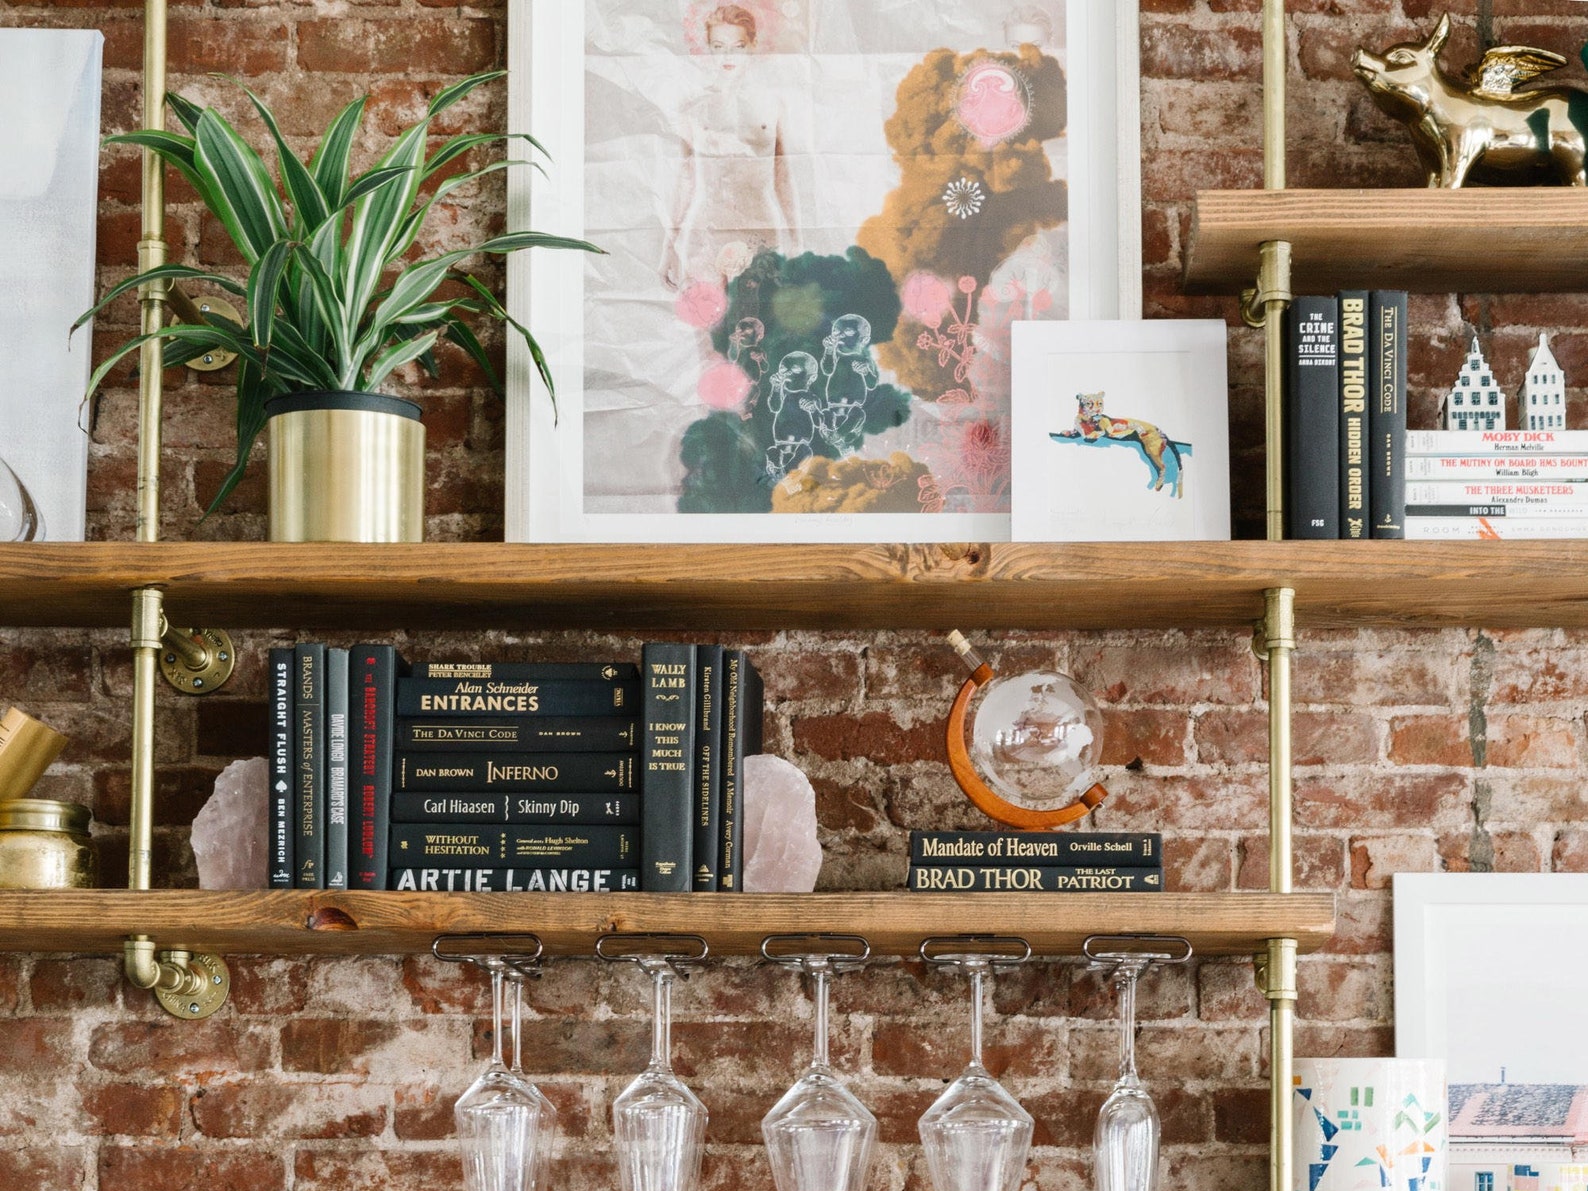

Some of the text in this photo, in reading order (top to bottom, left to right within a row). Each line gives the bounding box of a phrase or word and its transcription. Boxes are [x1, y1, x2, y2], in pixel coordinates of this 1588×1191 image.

[1310, 313, 1323, 321] THE
[1384, 307, 1394, 329] THE
[1299, 323, 1334, 333] CRIME
[1343, 299, 1364, 353] BRAD
[1302, 335, 1330, 343] AND THE
[1298, 344, 1336, 354] SILENCE
[1384, 348, 1395, 379] VINCI
[1343, 357, 1365, 413] THOR
[1384, 384, 1394, 412] CODE
[1348, 417, 1361, 465] HIDDEN
[1482, 432, 1555, 442] MOBY DICK
[1494, 443, 1519, 451] Herman
[1440, 459, 1458, 467] THE
[1460, 459, 1492, 467] MUTINY
[1494, 459, 1506, 467] ON
[1508, 458, 1537, 467] BOARD
[1349, 468, 1362, 509] ORDER
[1465, 485, 1574, 495] THE THREE MUSKETEERS
[1469, 506, 1505, 515] INTO THE
[651, 664, 687, 675] WALLY
[303, 656, 313, 699] BRANDS
[651, 677, 686, 688] LAMB
[455, 682, 539, 694] Alan Schneider
[421, 695, 539, 711] ENTRANCES
[277, 663, 287, 774] STRAIGHT FLUSH
[649, 723, 687, 732] I KNOW
[303, 710, 313, 760] MASTERS
[413, 729, 518, 739] THE DA VINCI CODE
[655, 736, 679, 745] THIS
[652, 749, 682, 758] MUCH
[487, 761, 559, 783] INFERNO
[649, 762, 686, 771] IS TRUE
[416, 768, 474, 778] DAN BROWN
[701, 745, 710, 827] OFF THE SIDELINES
[303, 773, 313, 837] ENTERPRISE
[424, 799, 495, 814] Carl Hiaasen
[518, 799, 580, 817] Skinny Dip
[426, 835, 479, 844] WITHOUT
[425, 846, 490, 855] HESITATION
[922, 838, 1058, 857] Mandate of Heaven
[1070, 842, 1102, 852] Orville
[1104, 842, 1133, 852] Schell
[397, 869, 494, 892] ARTIE
[506, 869, 611, 892] LANGE
[916, 868, 1044, 890] BRAD THOR
[1057, 875, 1135, 889] PATRIOT
